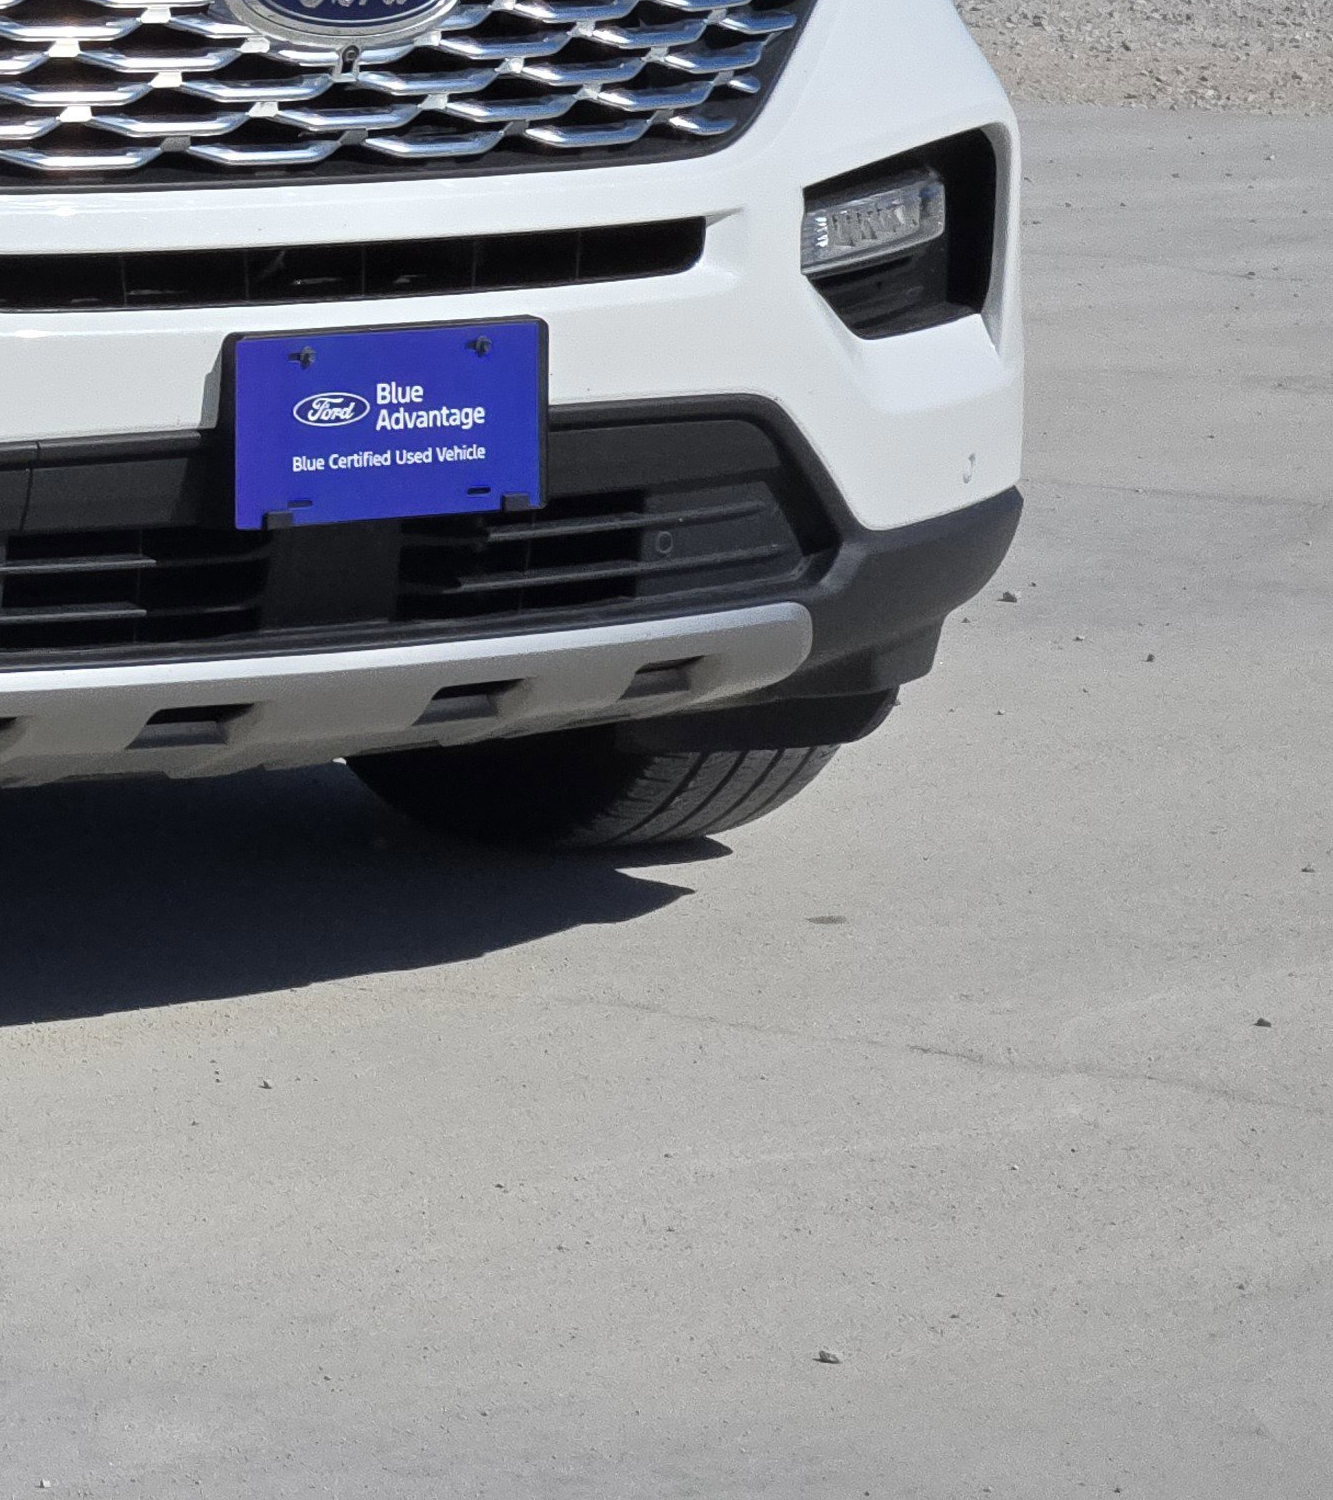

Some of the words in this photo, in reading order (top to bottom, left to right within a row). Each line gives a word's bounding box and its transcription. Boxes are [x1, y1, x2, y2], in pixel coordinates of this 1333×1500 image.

[376, 381, 424, 405] Blue
[307, 397, 356, 421] Ford
[375, 405, 486, 431] Advantage
[292, 456, 325, 472] Blue
[328, 450, 391, 469] Certified
[395, 447, 433, 465] Used
[435, 443, 486, 462] Vehicle
